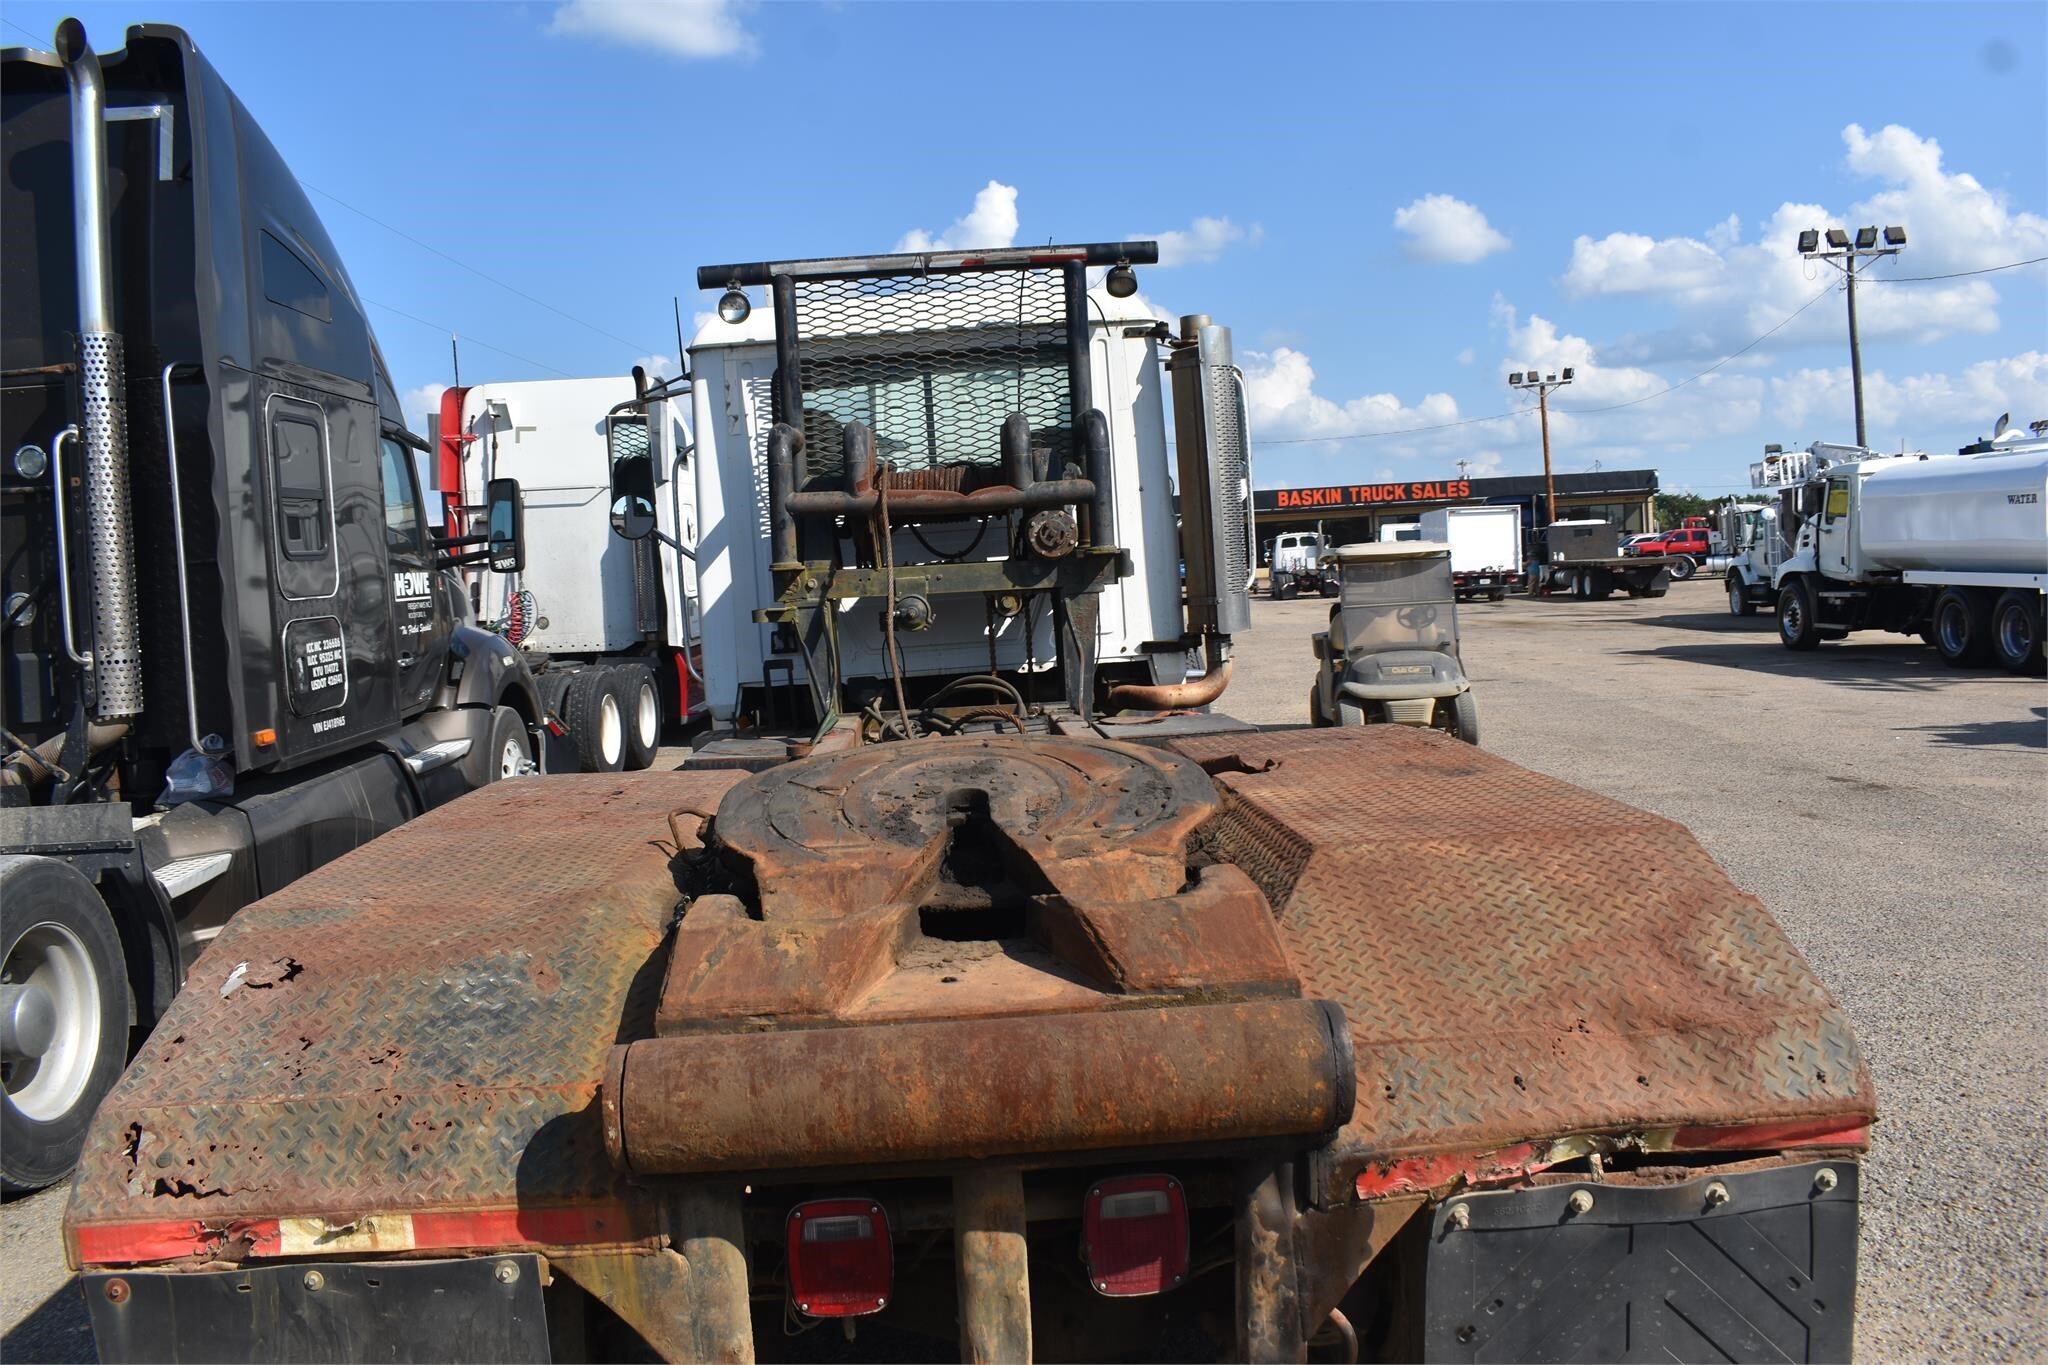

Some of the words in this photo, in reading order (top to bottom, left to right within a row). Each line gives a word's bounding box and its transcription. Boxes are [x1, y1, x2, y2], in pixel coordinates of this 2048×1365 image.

[1277, 488, 1342, 507] BASKIN
[1348, 484, 1406, 503] TRUCK
[1411, 481, 1470, 499] SALES
[2007, 493, 2038, 504] WATER
[394, 571, 431, 596] HOWE
[311, 677, 327, 691] USDOT
